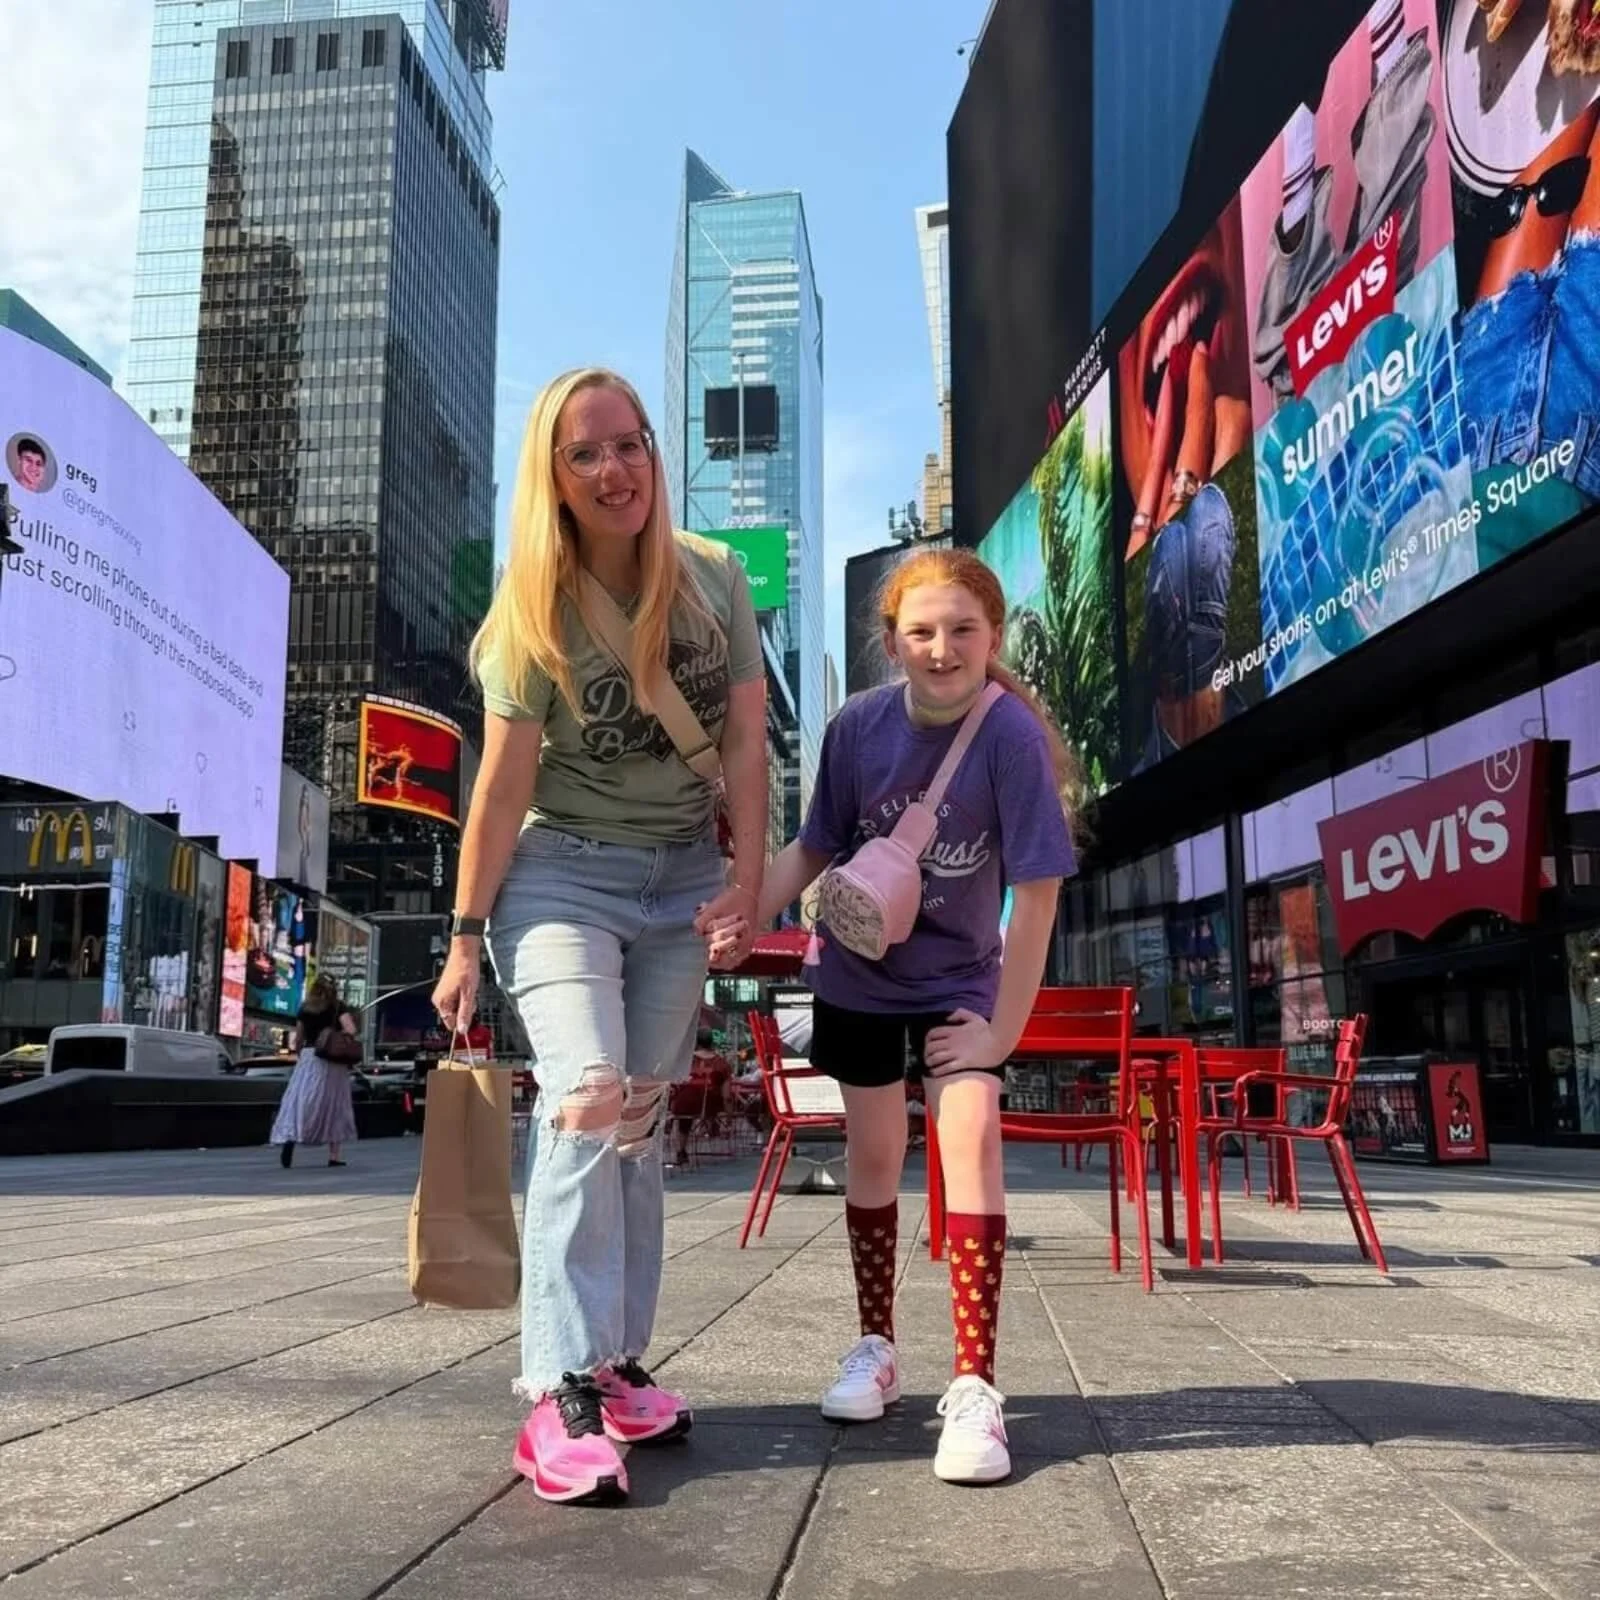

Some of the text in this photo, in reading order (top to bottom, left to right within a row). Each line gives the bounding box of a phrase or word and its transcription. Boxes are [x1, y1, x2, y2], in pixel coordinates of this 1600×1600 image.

[1065, 327, 1106, 395] MARRIOTT
[1283, 331, 1418, 485] summer
[66, 463, 97, 493] greg
[84, 549, 110, 577] me
[112, 568, 149, 608] phone
[151, 598, 169, 624] out
[170, 609, 201, 654] during
[1211, 661, 1234, 692] Get
[1237, 641, 1267, 682] your
[1269, 612, 1312, 656] shorts
[1315, 597, 1337, 625] on
[1340, 579, 1359, 609] at
[1421, 500, 1482, 556] Times
[1487, 439, 1575, 513] Square
[7, 552, 45, 582] ust
[50, 569, 122, 627] scrolling
[124, 606, 167, 655] through
[169, 641, 186, 668] the
[237, 696, 254, 719] app
[1449, 1123, 1473, 1139] MJ
